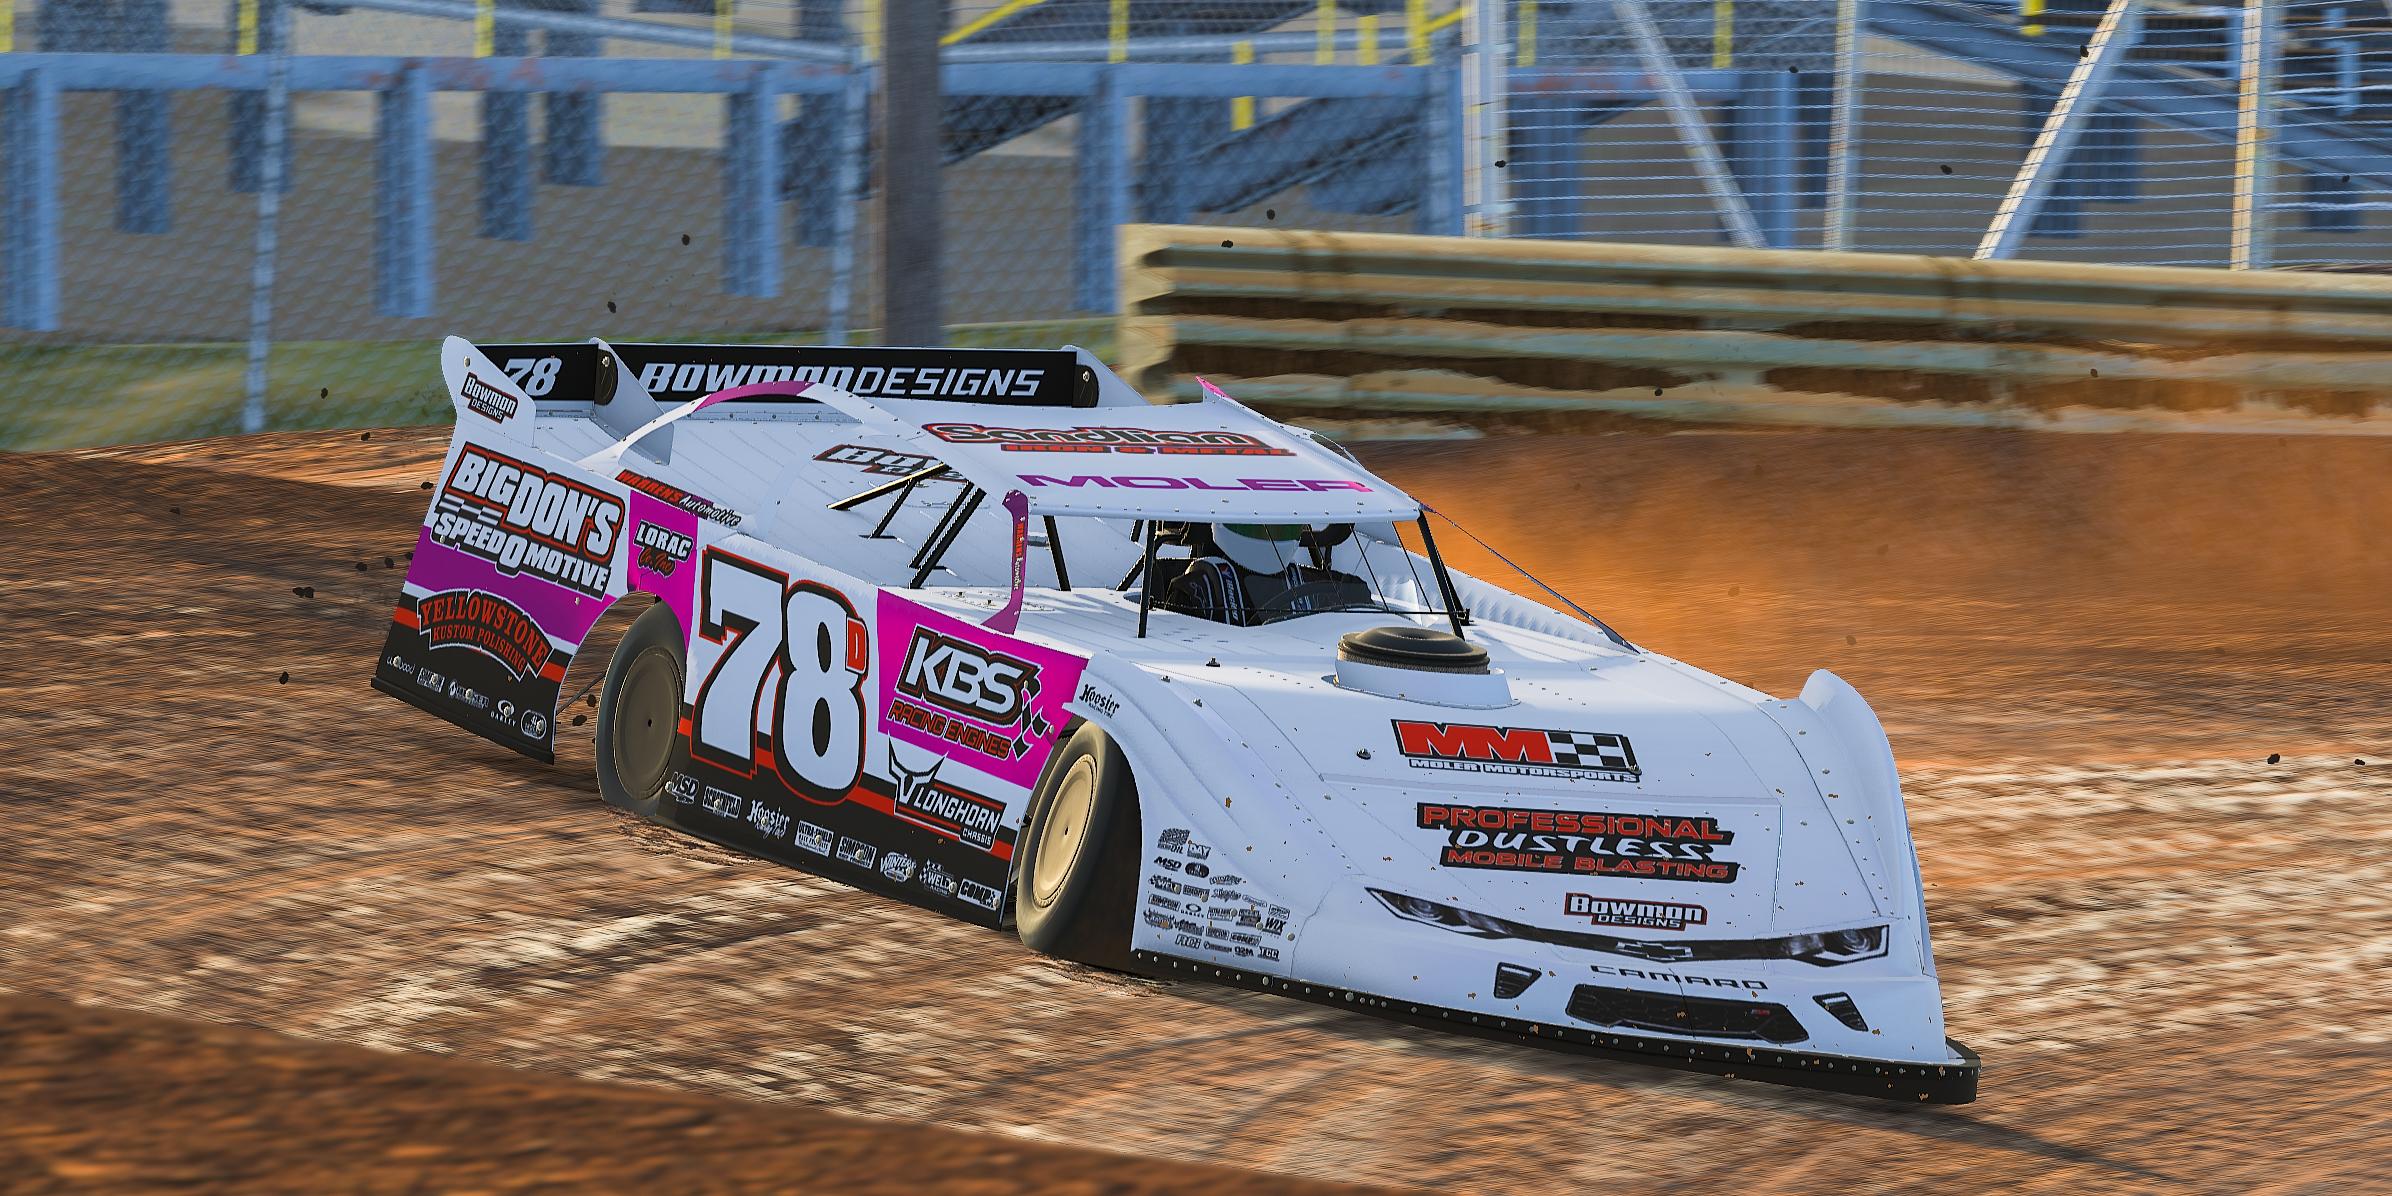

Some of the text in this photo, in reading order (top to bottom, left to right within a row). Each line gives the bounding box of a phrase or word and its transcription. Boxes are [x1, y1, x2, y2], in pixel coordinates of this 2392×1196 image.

[503, 357, 563, 397] 78
[471, 398, 504, 420] DESIGNS
[1004, 444, 1106, 453] IRON
[1016, 474, 1374, 493] MOLER
[679, 495, 742, 527] Automotive
[636, 521, 693, 558] LORAC
[420, 595, 549, 669] YELLOWSTONE
[847, 619, 867, 673] D
[433, 624, 528, 673] KUSTOM POLISHING
[904, 636, 1023, 714] KBS
[1079, 683, 1120, 715] Hoosier
[888, 700, 1012, 759] RACING ENGINES
[1398, 720, 1553, 763] MM
[1410, 758, 1641, 783] MOLER MOTORSPORTS
[913, 786, 1000, 833] LONGHORN
[1423, 806, 1725, 841] PROFESSIONAL
[962, 827, 991, 846] CHASSIS
[1455, 830, 1718, 861] DUSTLESS
[1447, 849, 1729, 879] MOBILE BLASTING
[1597, 914, 1681, 929] DESIGNS
[1590, 965, 1769, 990] CAMARO
